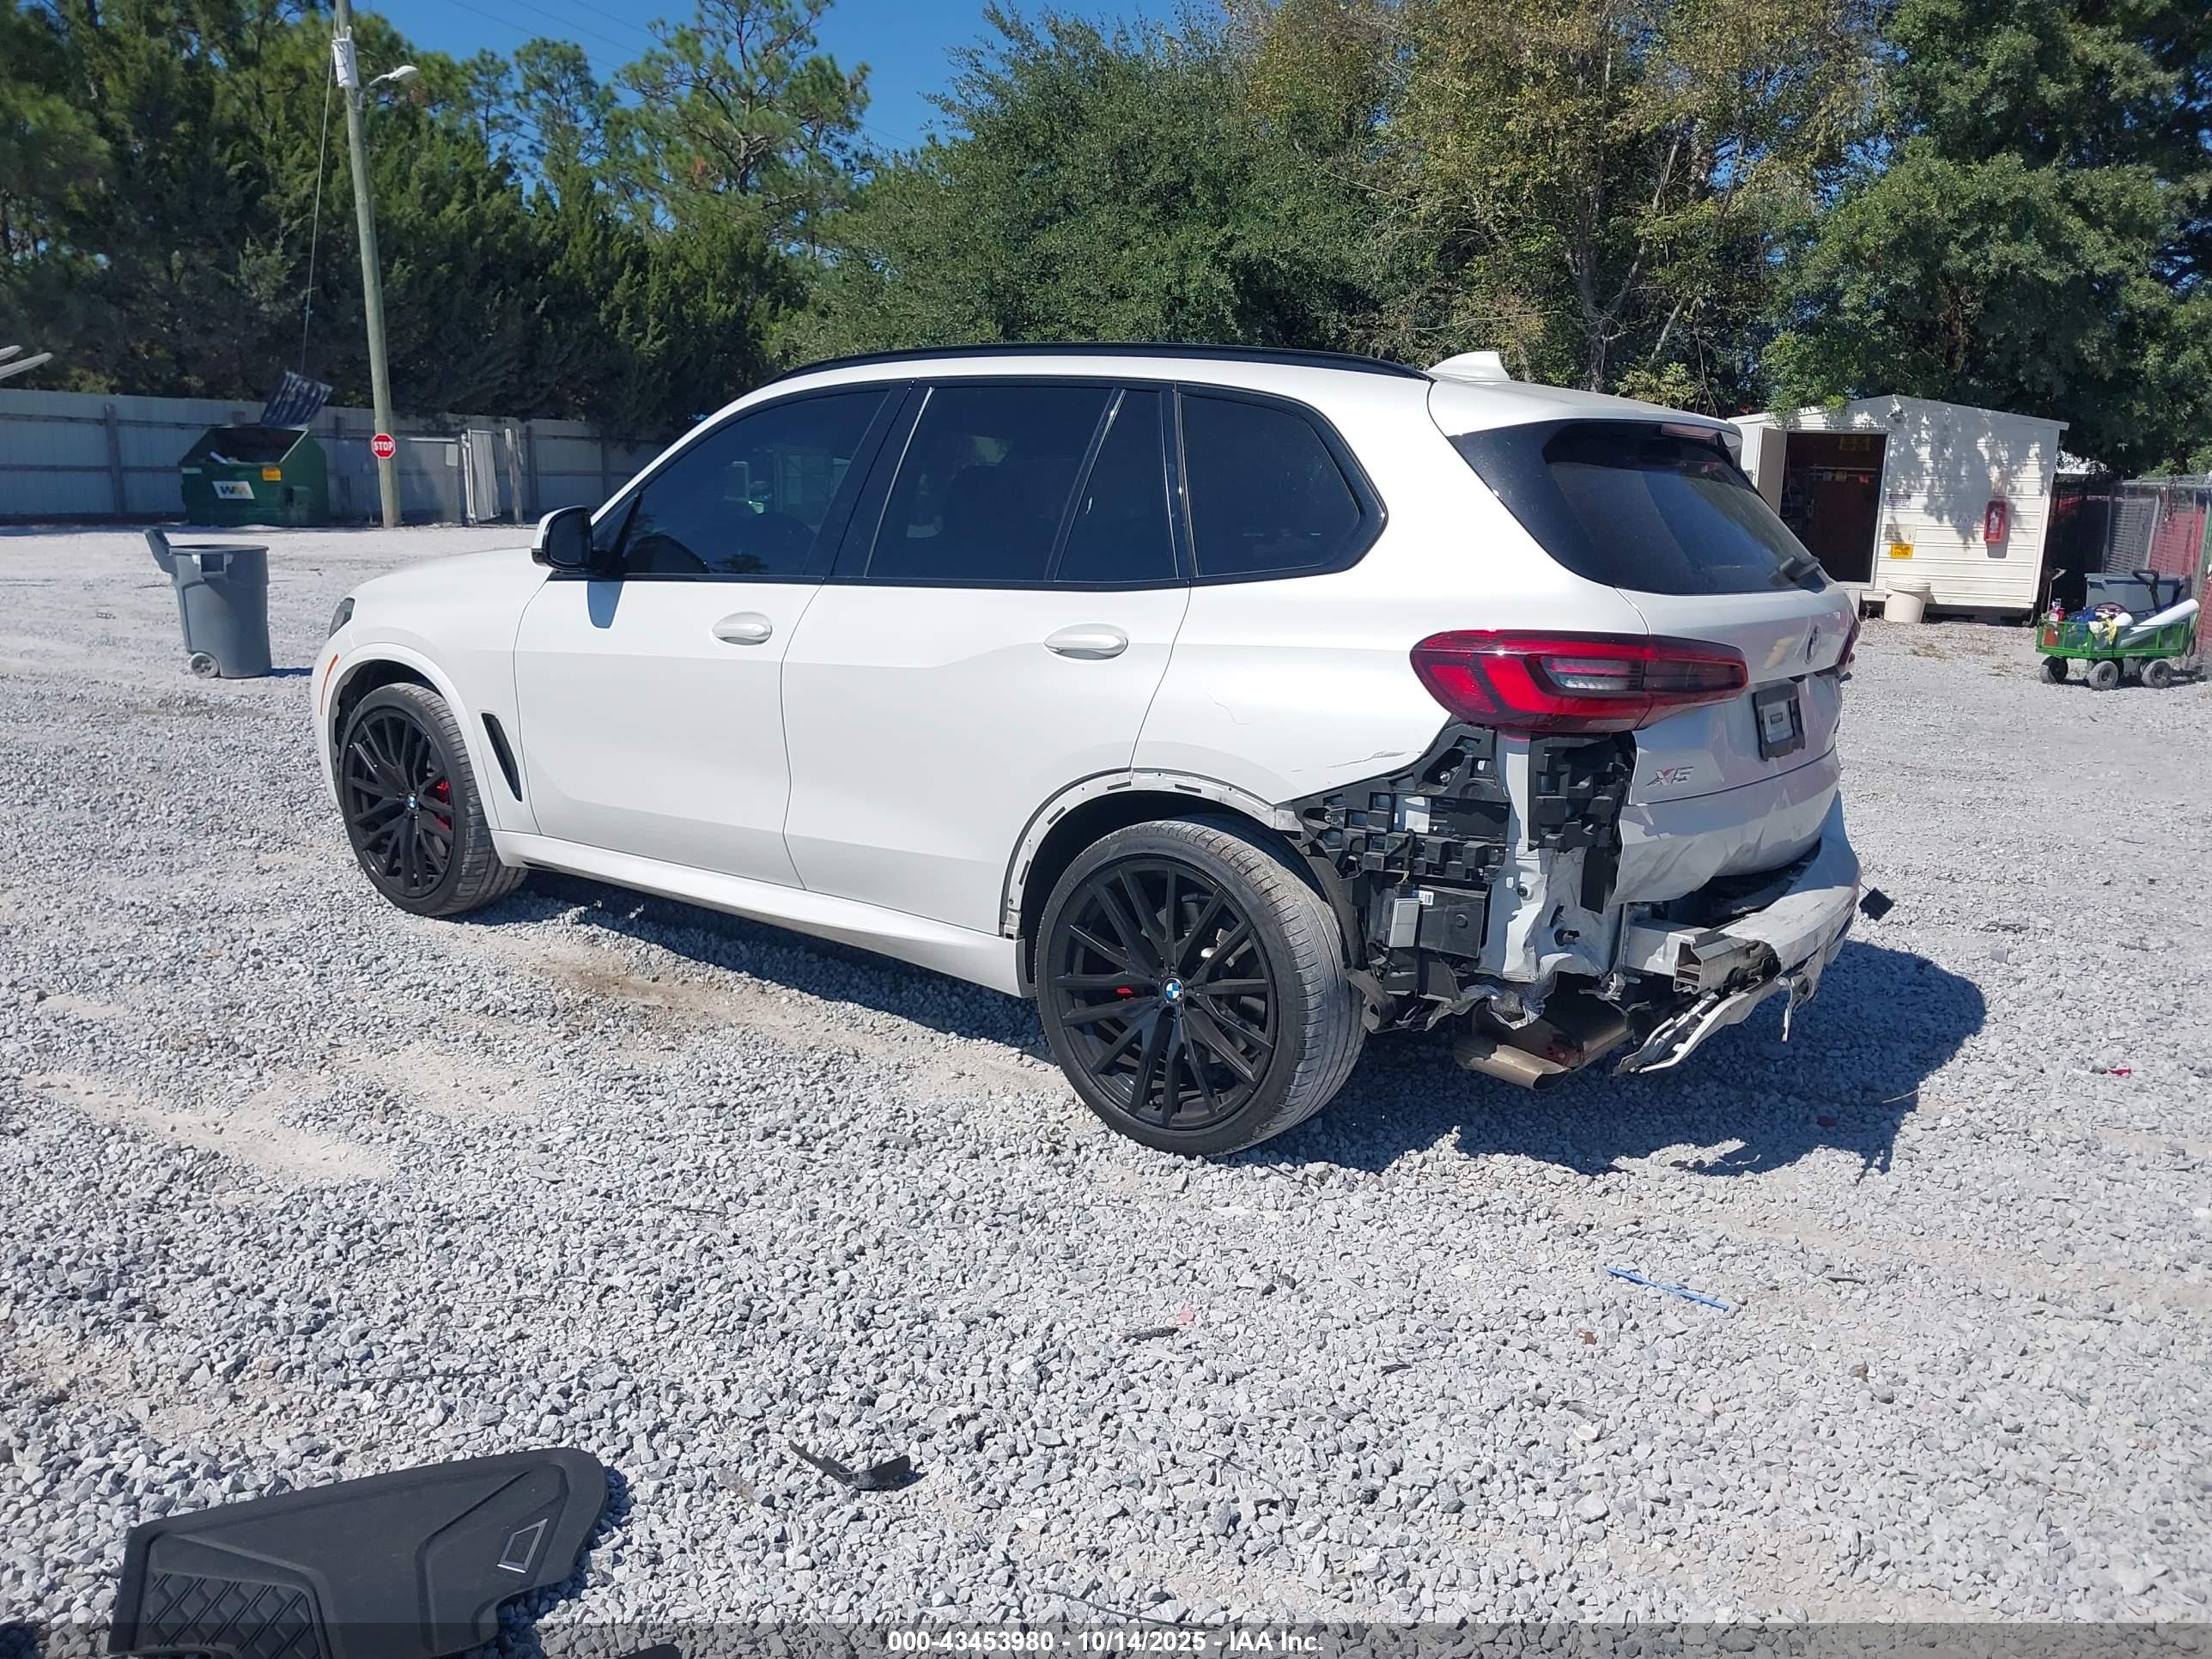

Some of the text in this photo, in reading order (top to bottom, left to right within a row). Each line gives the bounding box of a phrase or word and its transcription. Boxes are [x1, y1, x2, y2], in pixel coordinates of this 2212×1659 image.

[374, 441, 393, 452] STOP
[220, 485, 250, 495] WM
[1645, 766, 1694, 787] X5
